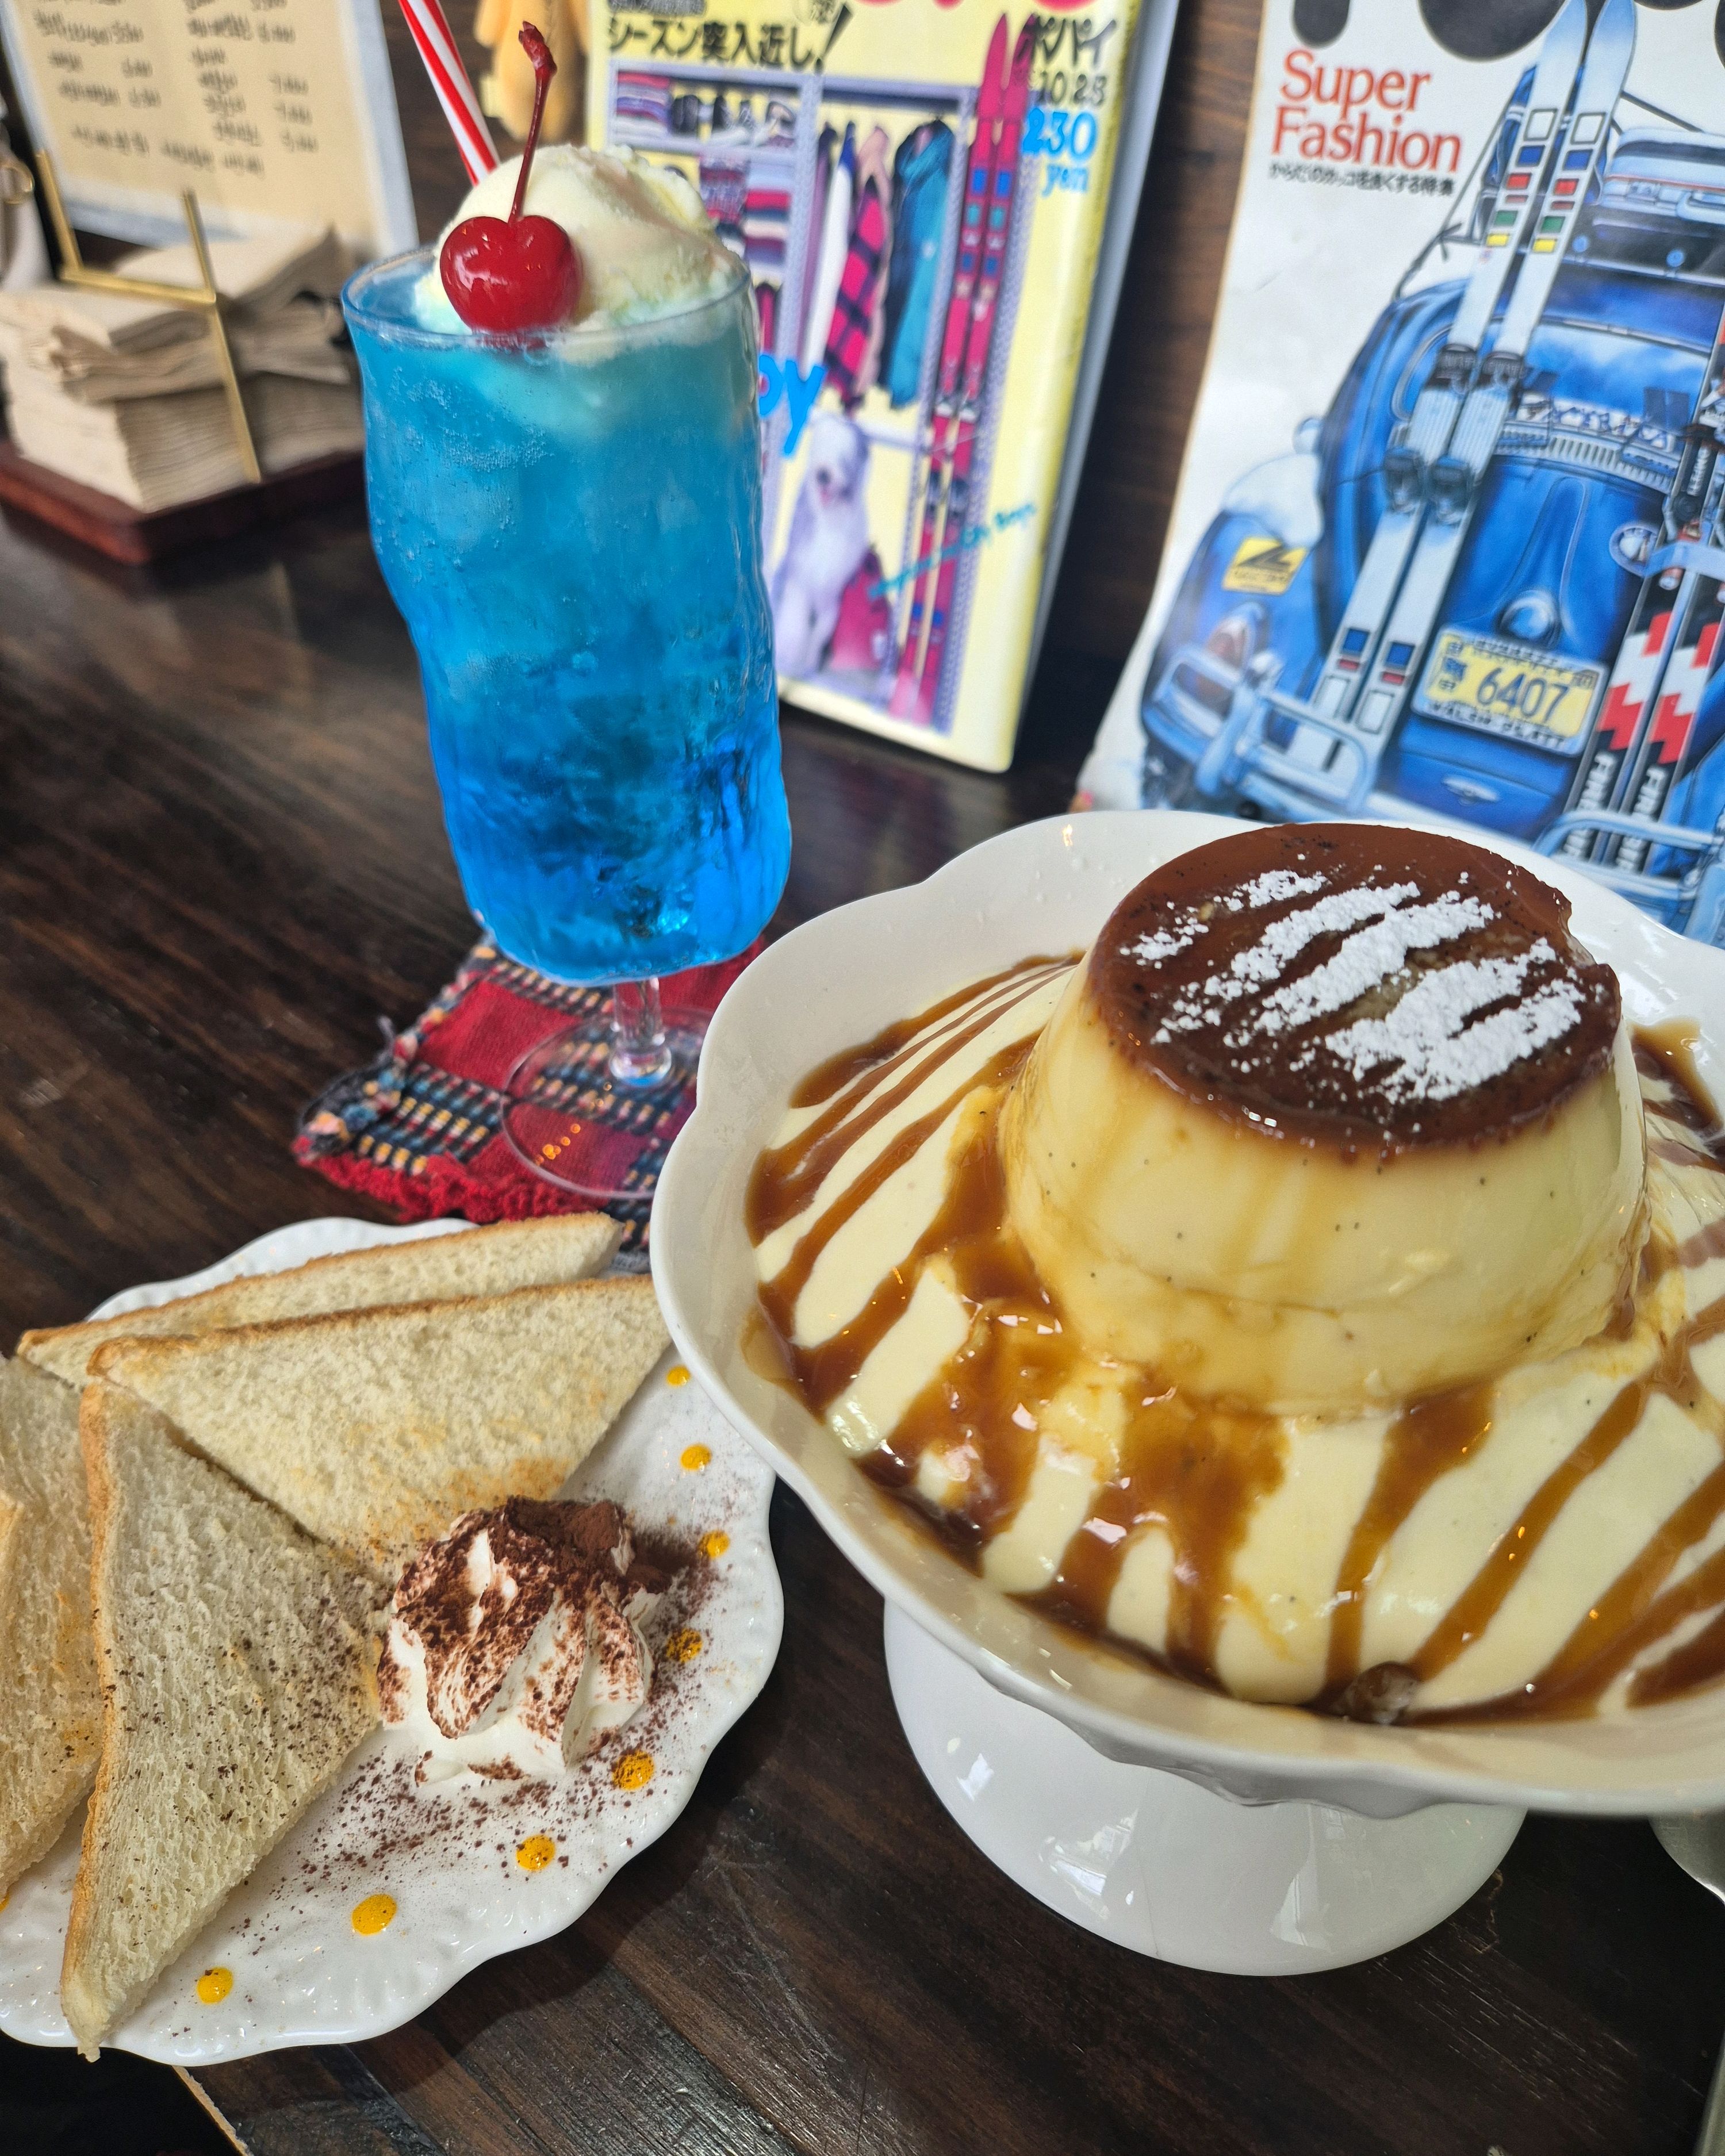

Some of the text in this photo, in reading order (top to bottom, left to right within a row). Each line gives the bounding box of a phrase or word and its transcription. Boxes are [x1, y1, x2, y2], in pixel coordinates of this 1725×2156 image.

[1279, 49, 1431, 120] Super
[1022, 107, 1098, 159] 230
[1271, 105, 1461, 172] Fashion
[1040, 163, 1088, 197] yen
[1477, 667, 1571, 723] 6407
